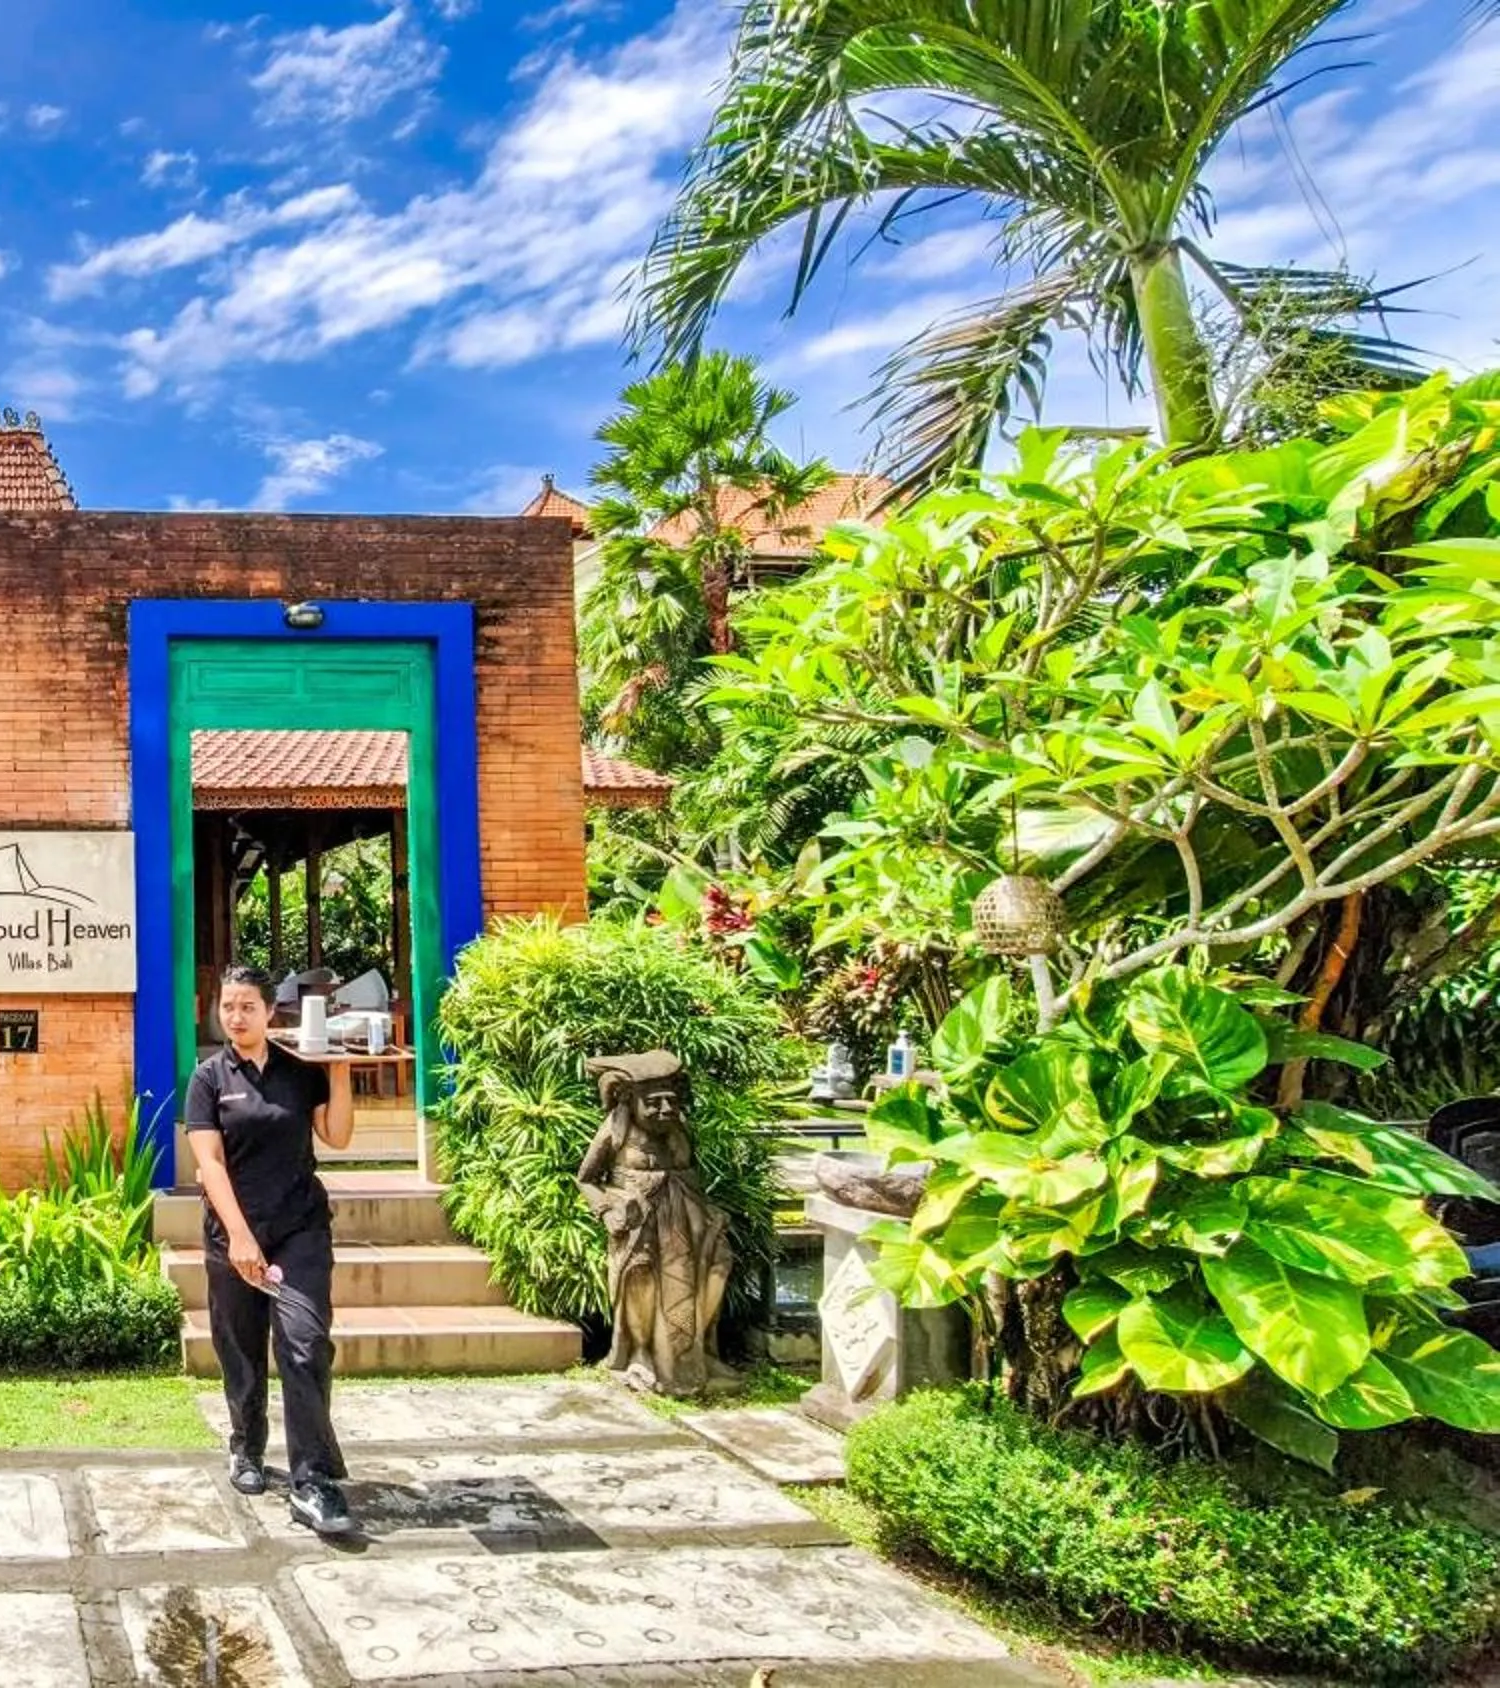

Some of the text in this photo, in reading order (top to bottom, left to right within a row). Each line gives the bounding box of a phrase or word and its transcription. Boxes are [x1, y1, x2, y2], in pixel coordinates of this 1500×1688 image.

[48, 908, 131, 946] Heaven
[7, 952, 73, 972] Villas Bali
[2, 1025, 33, 1049] 17
